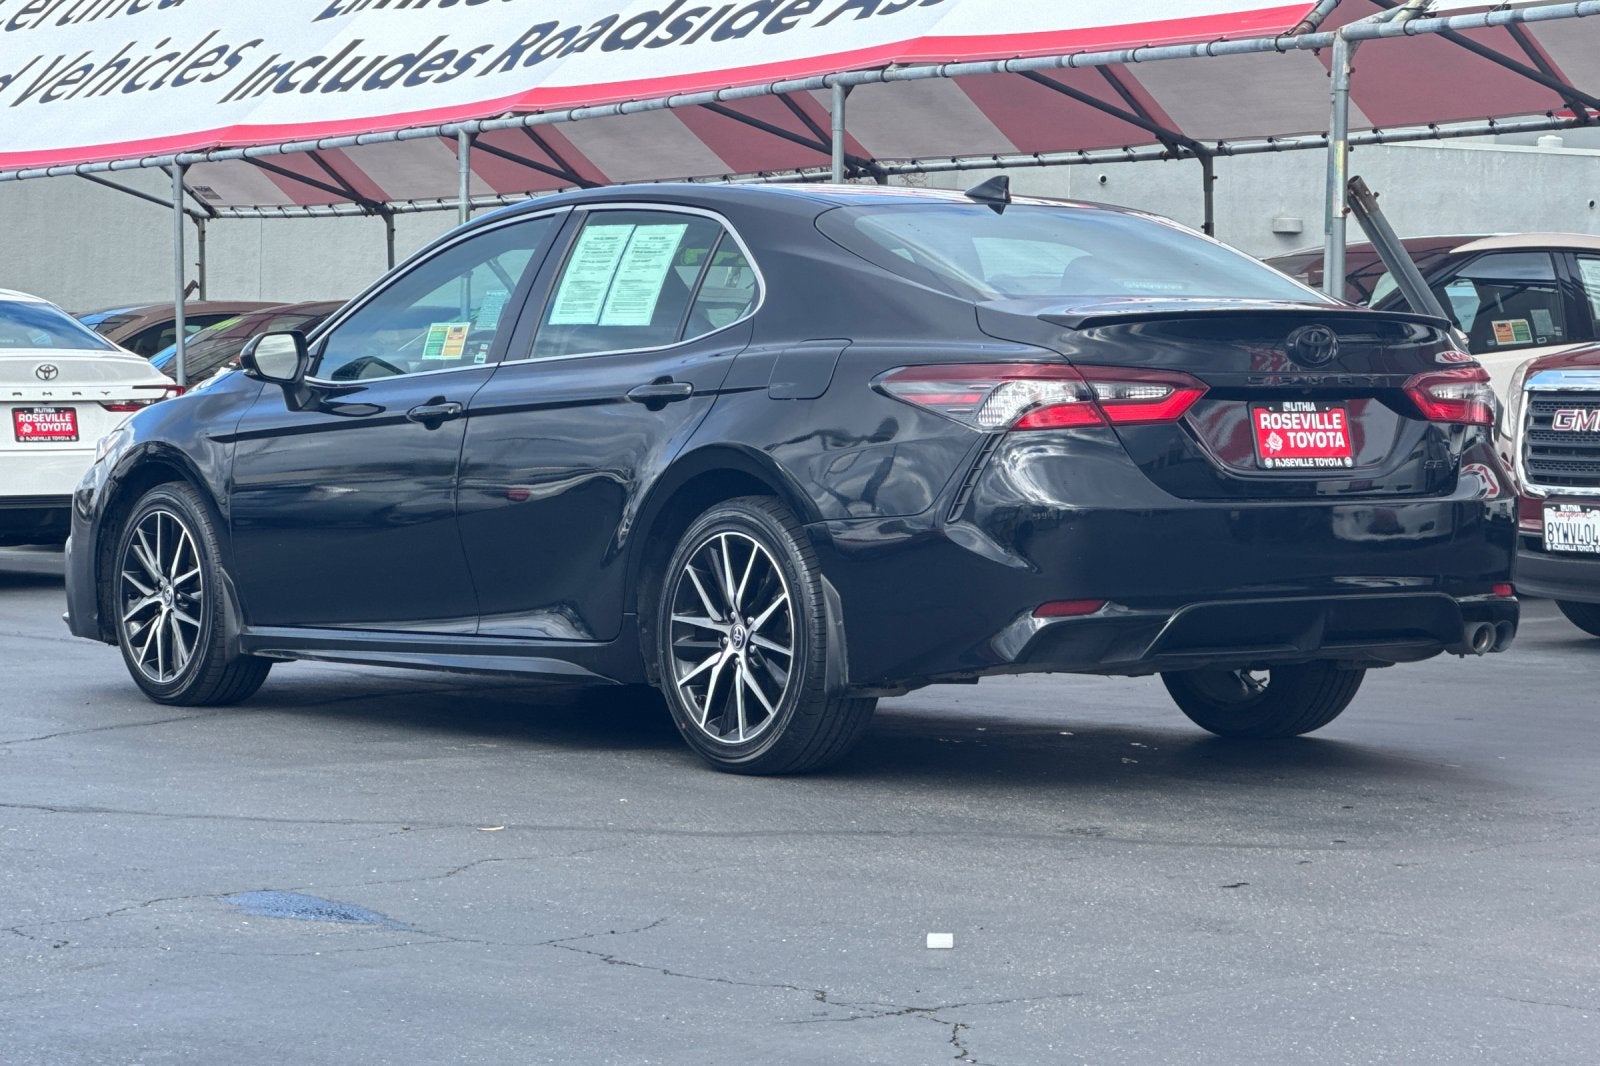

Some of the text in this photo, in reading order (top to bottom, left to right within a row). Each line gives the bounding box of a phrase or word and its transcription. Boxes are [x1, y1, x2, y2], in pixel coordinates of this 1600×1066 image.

[9, 29, 264, 107] Vehicles
[216, 34, 495, 104] Includes
[475, 0, 823, 77] Roadside
[1291, 402, 1317, 411] LITHIA
[18, 413, 71, 423] ROSEVILLE
[1260, 413, 1342, 430] ROSEVILLE
[1552, 409, 1600, 432] GM
[35, 423, 73, 432] TOYOTA
[1287, 432, 1346, 448] TOYOTA
[1275, 458, 1343, 467] ROSEVILLE TOYOTA
